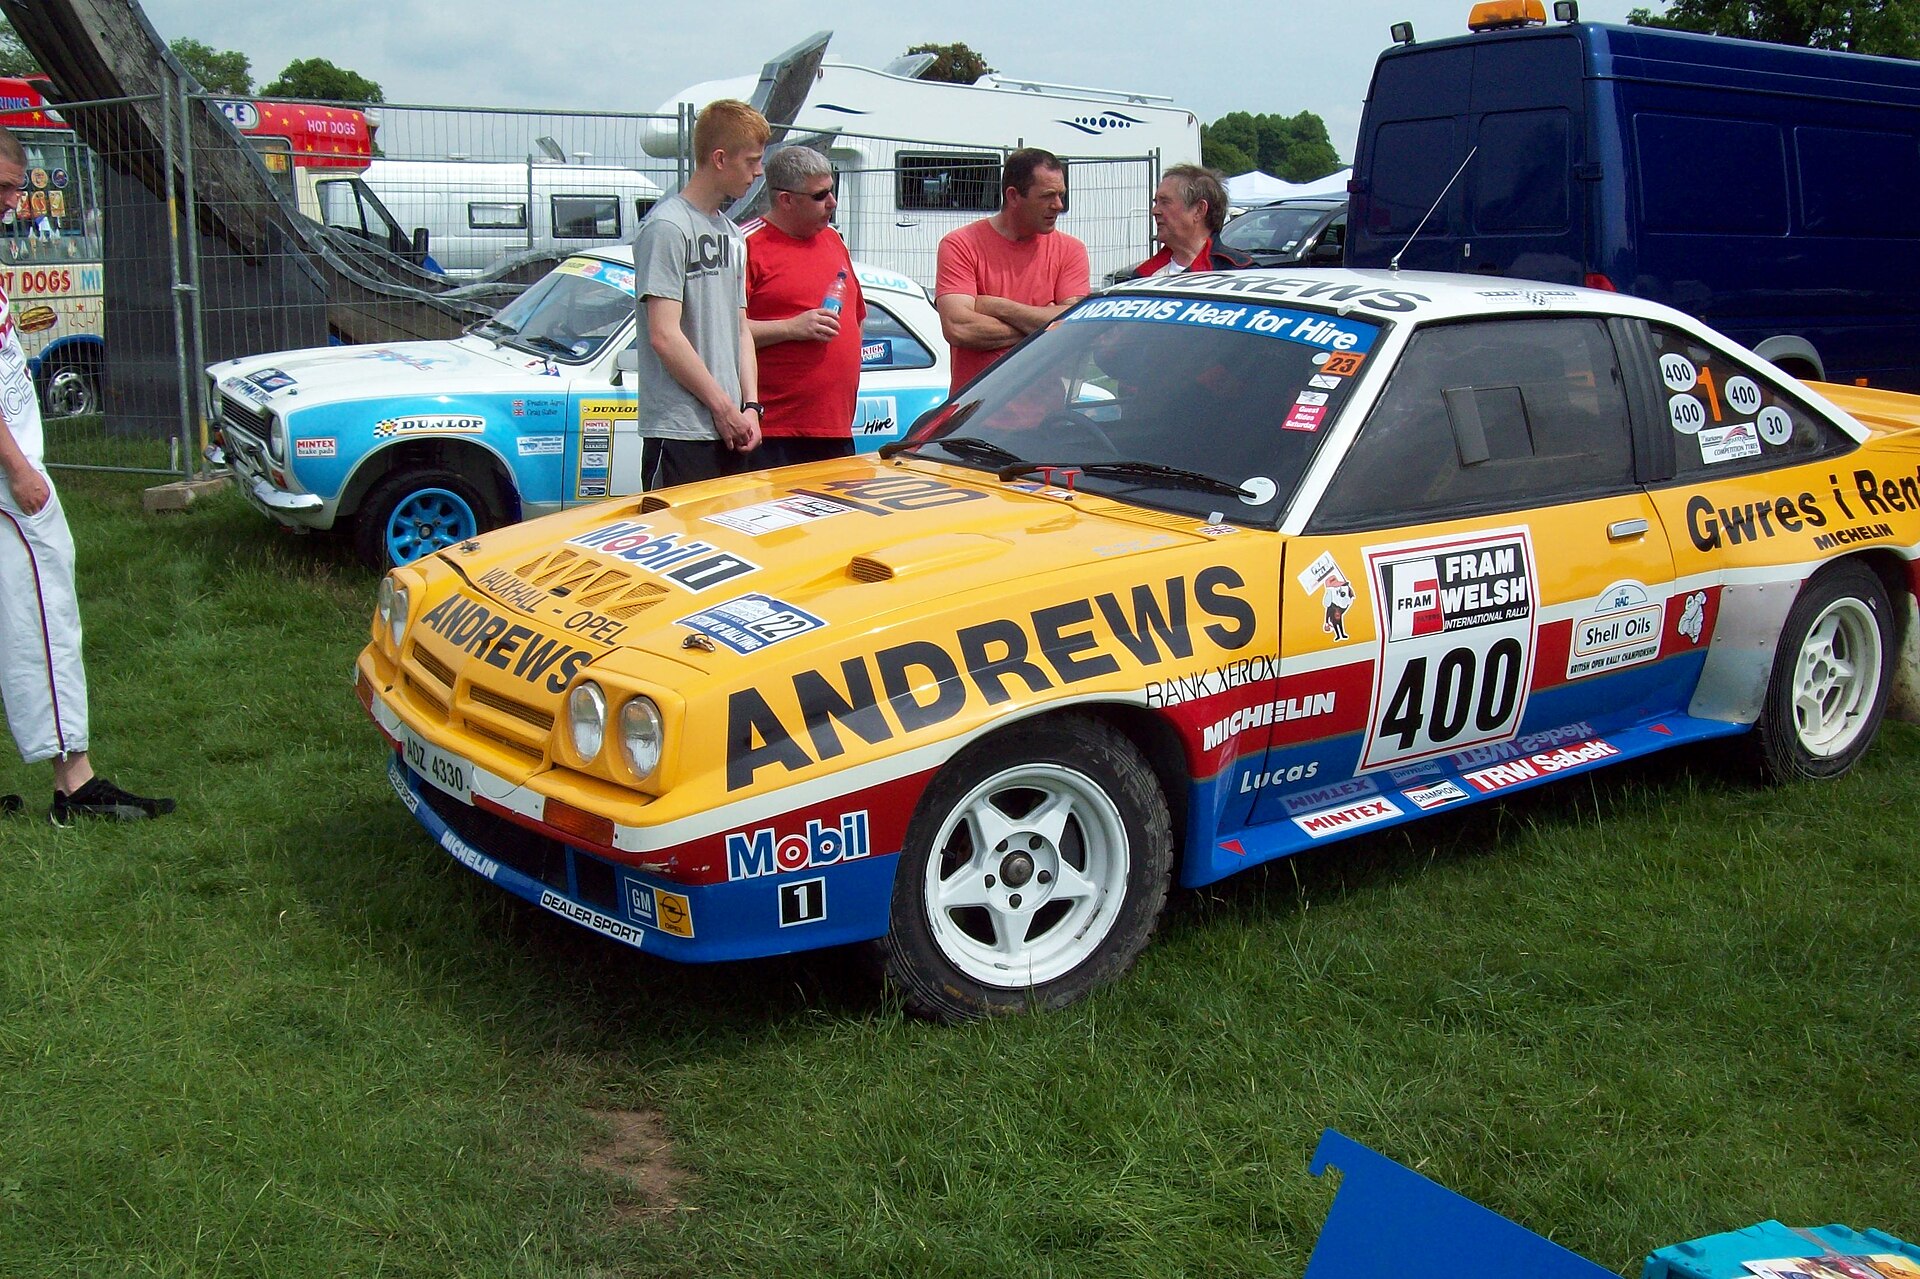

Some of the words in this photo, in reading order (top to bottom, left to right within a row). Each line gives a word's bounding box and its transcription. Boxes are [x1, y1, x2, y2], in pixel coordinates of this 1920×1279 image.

[307, 119, 327, 133] HOT
[330, 121, 356, 135] DOGS
[22, 270, 71, 294] DOGS
[861, 272, 908, 290] CLUB
[1065, 300, 1183, 320] ANDREWS
[1176, 302, 1247, 326] Heat
[1244, 309, 1293, 333] for
[1289, 317, 1358, 349] Hire
[1326, 357, 1356, 373] 23
[1665, 363, 1691, 382] 400
[1697, 366, 1722, 422] 1
[1731, 385, 1756, 404] 400
[401, 419, 483, 430] DUNLOP
[864, 417, 894, 435] Hire
[1285, 420, 1317, 430] Saturday
[1674, 403, 1699, 424] 400
[1766, 415, 1783, 435] 30
[297, 440, 334, 448] MINTEX
[318, 447, 334, 455] pads
[1686, 495, 1827, 552] Gwres
[1829, 474, 1855, 519] i
[1853, 465, 1920, 516] Ren
[570, 522, 713, 570] Mobil
[1813, 523, 1894, 551] MICHELIN
[1445, 548, 1515, 583] FRAM
[476, 567, 549, 614] VAUXHALL
[563, 610, 629, 646] OPEL
[1398, 594, 1432, 610] FRAM
[1440, 576, 1526, 614] WELSH
[1614, 596, 1630, 608] RAC
[750, 615, 807, 639] 22
[1444, 613, 1503, 630] INTERNATIONAL
[1505, 606, 1529, 620] RALLY
[1585, 623, 1619, 646] Shell
[1625, 617, 1651, 637] Oils
[421, 593, 593, 694] ANDREWS
[1570, 662, 1590, 674] BRITISH
[1591, 659, 1604, 669] OPEN
[1605, 654, 1620, 666] RALLY
[1621, 645, 1657, 662] CHAMPIONSHIP
[726, 566, 1257, 792] ANDREWS
[1145, 668, 1212, 708] RANK
[1216, 653, 1277, 693] XEROX
[1379, 637, 1522, 751] 400
[1203, 691, 1336, 751] MICHELIN
[407, 736, 427, 772] ADZ
[432, 755, 464, 792] 4330
[1240, 761, 1319, 794] Lucas
[1463, 760, 1539, 792] TRW
[1532, 739, 1619, 772] Sabelt
[1412, 785, 1459, 803] CHAMPION
[1303, 802, 1391, 832] MINTEX
[440, 830, 499, 880] MICHELIN
[728, 811, 869, 880] Mobil
[632, 888, 651, 913] GM
[542, 893, 593, 925] DEALER
[592, 915, 642, 943] SPORT
[664, 922, 685, 934] OPEL
